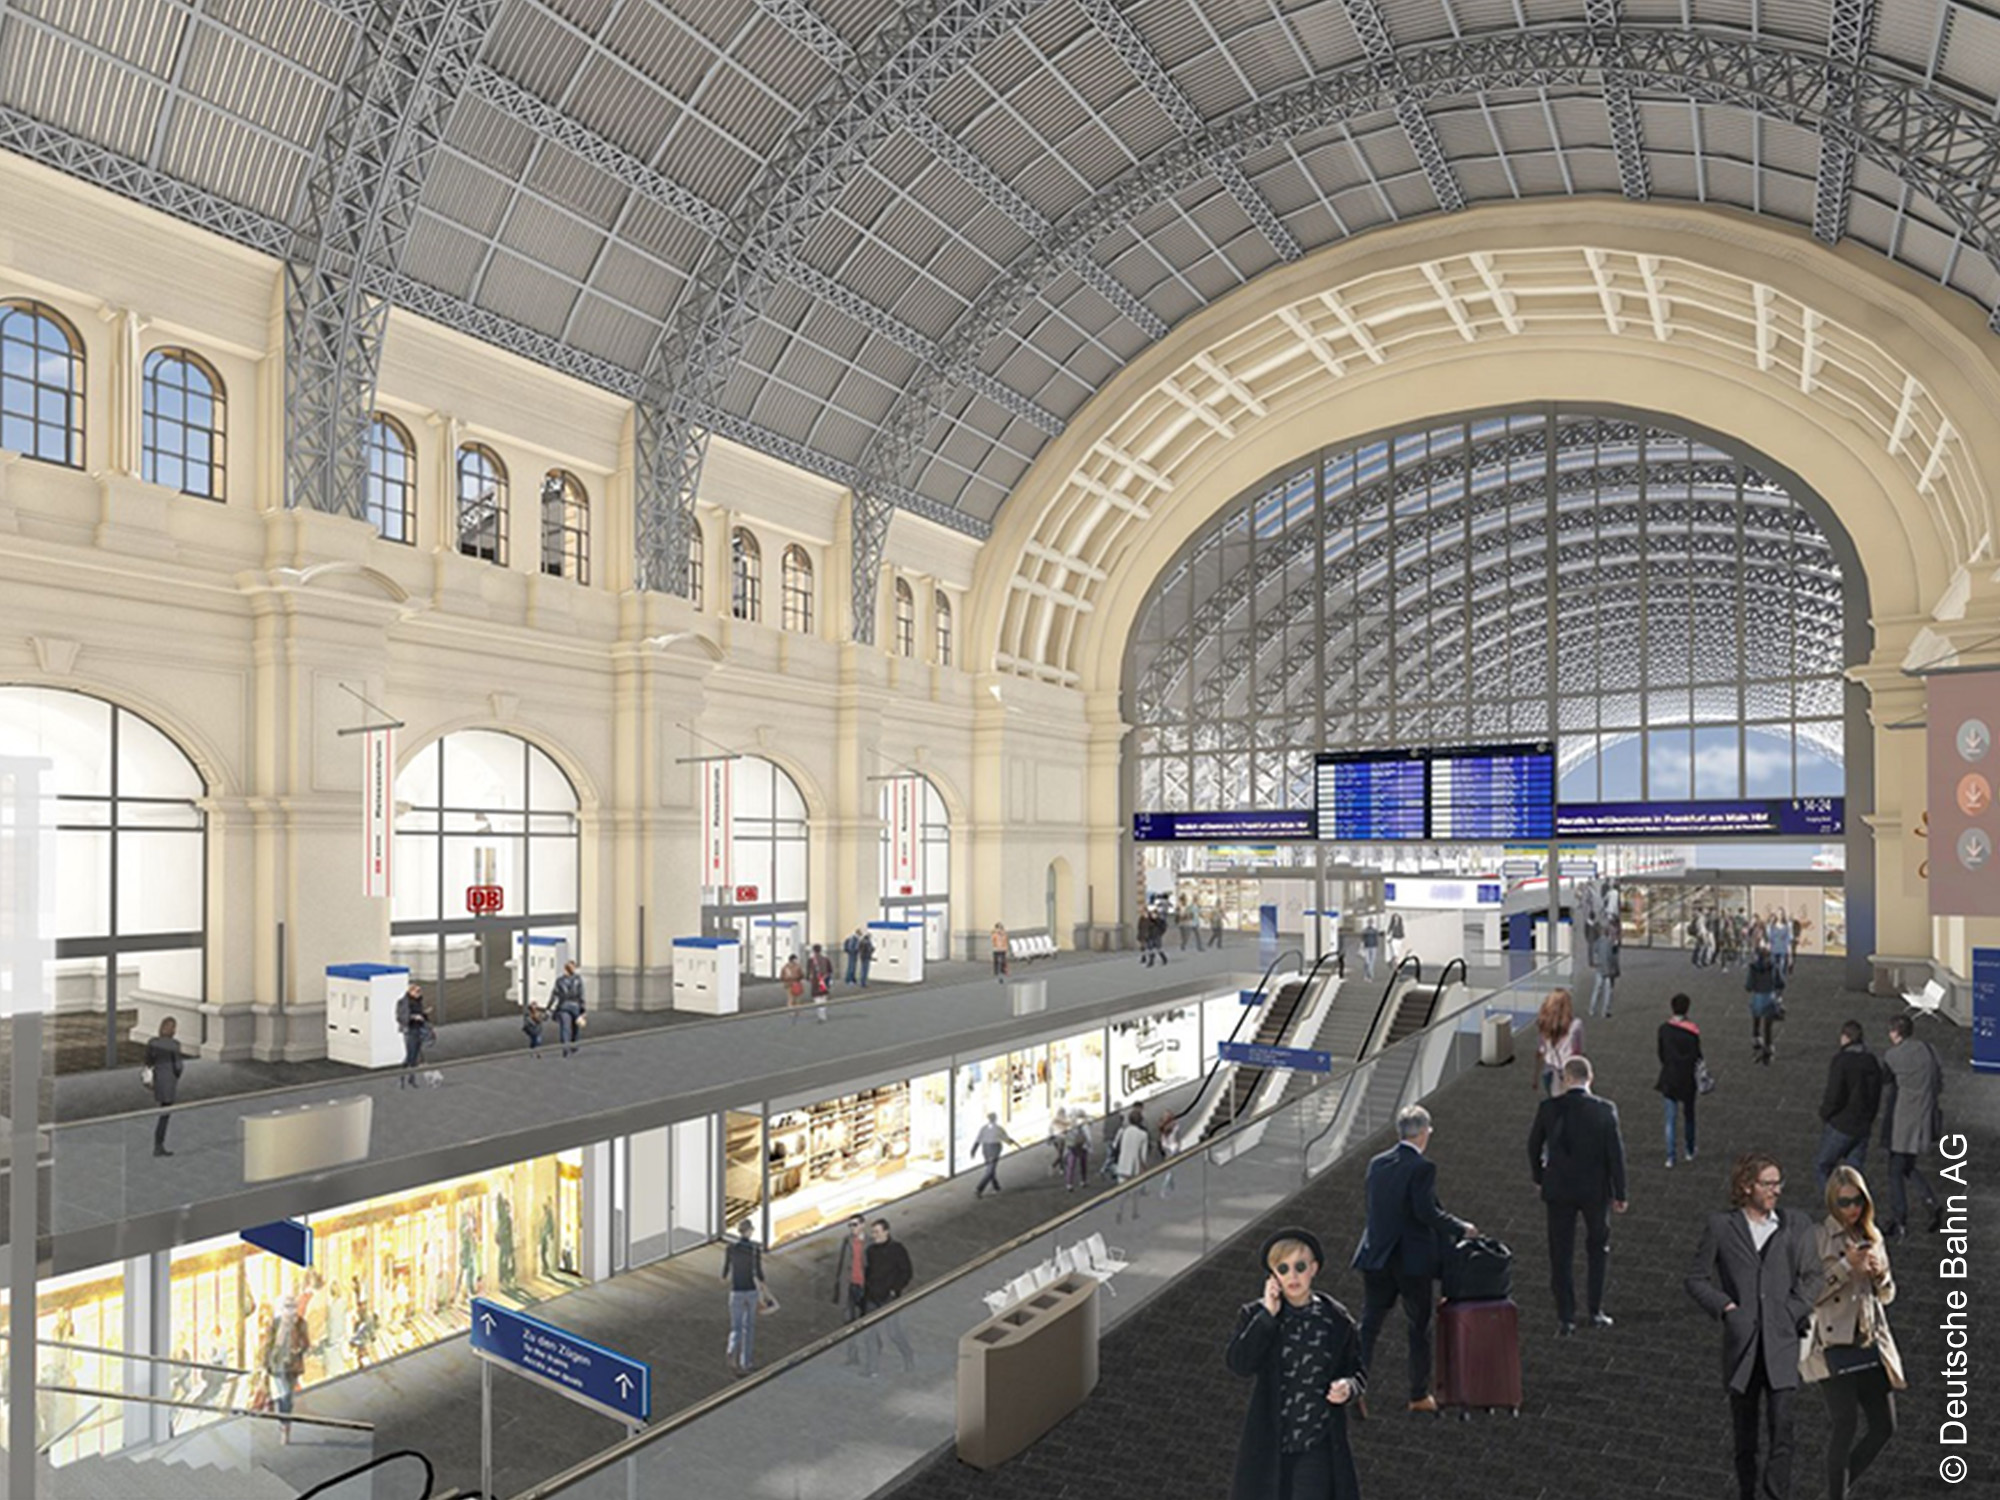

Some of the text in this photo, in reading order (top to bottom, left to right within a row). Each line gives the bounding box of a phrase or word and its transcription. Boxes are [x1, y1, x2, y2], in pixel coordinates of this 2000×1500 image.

[470, 889, 501, 909] DB
[522, 1328, 592, 1367] Zu den Zügen
